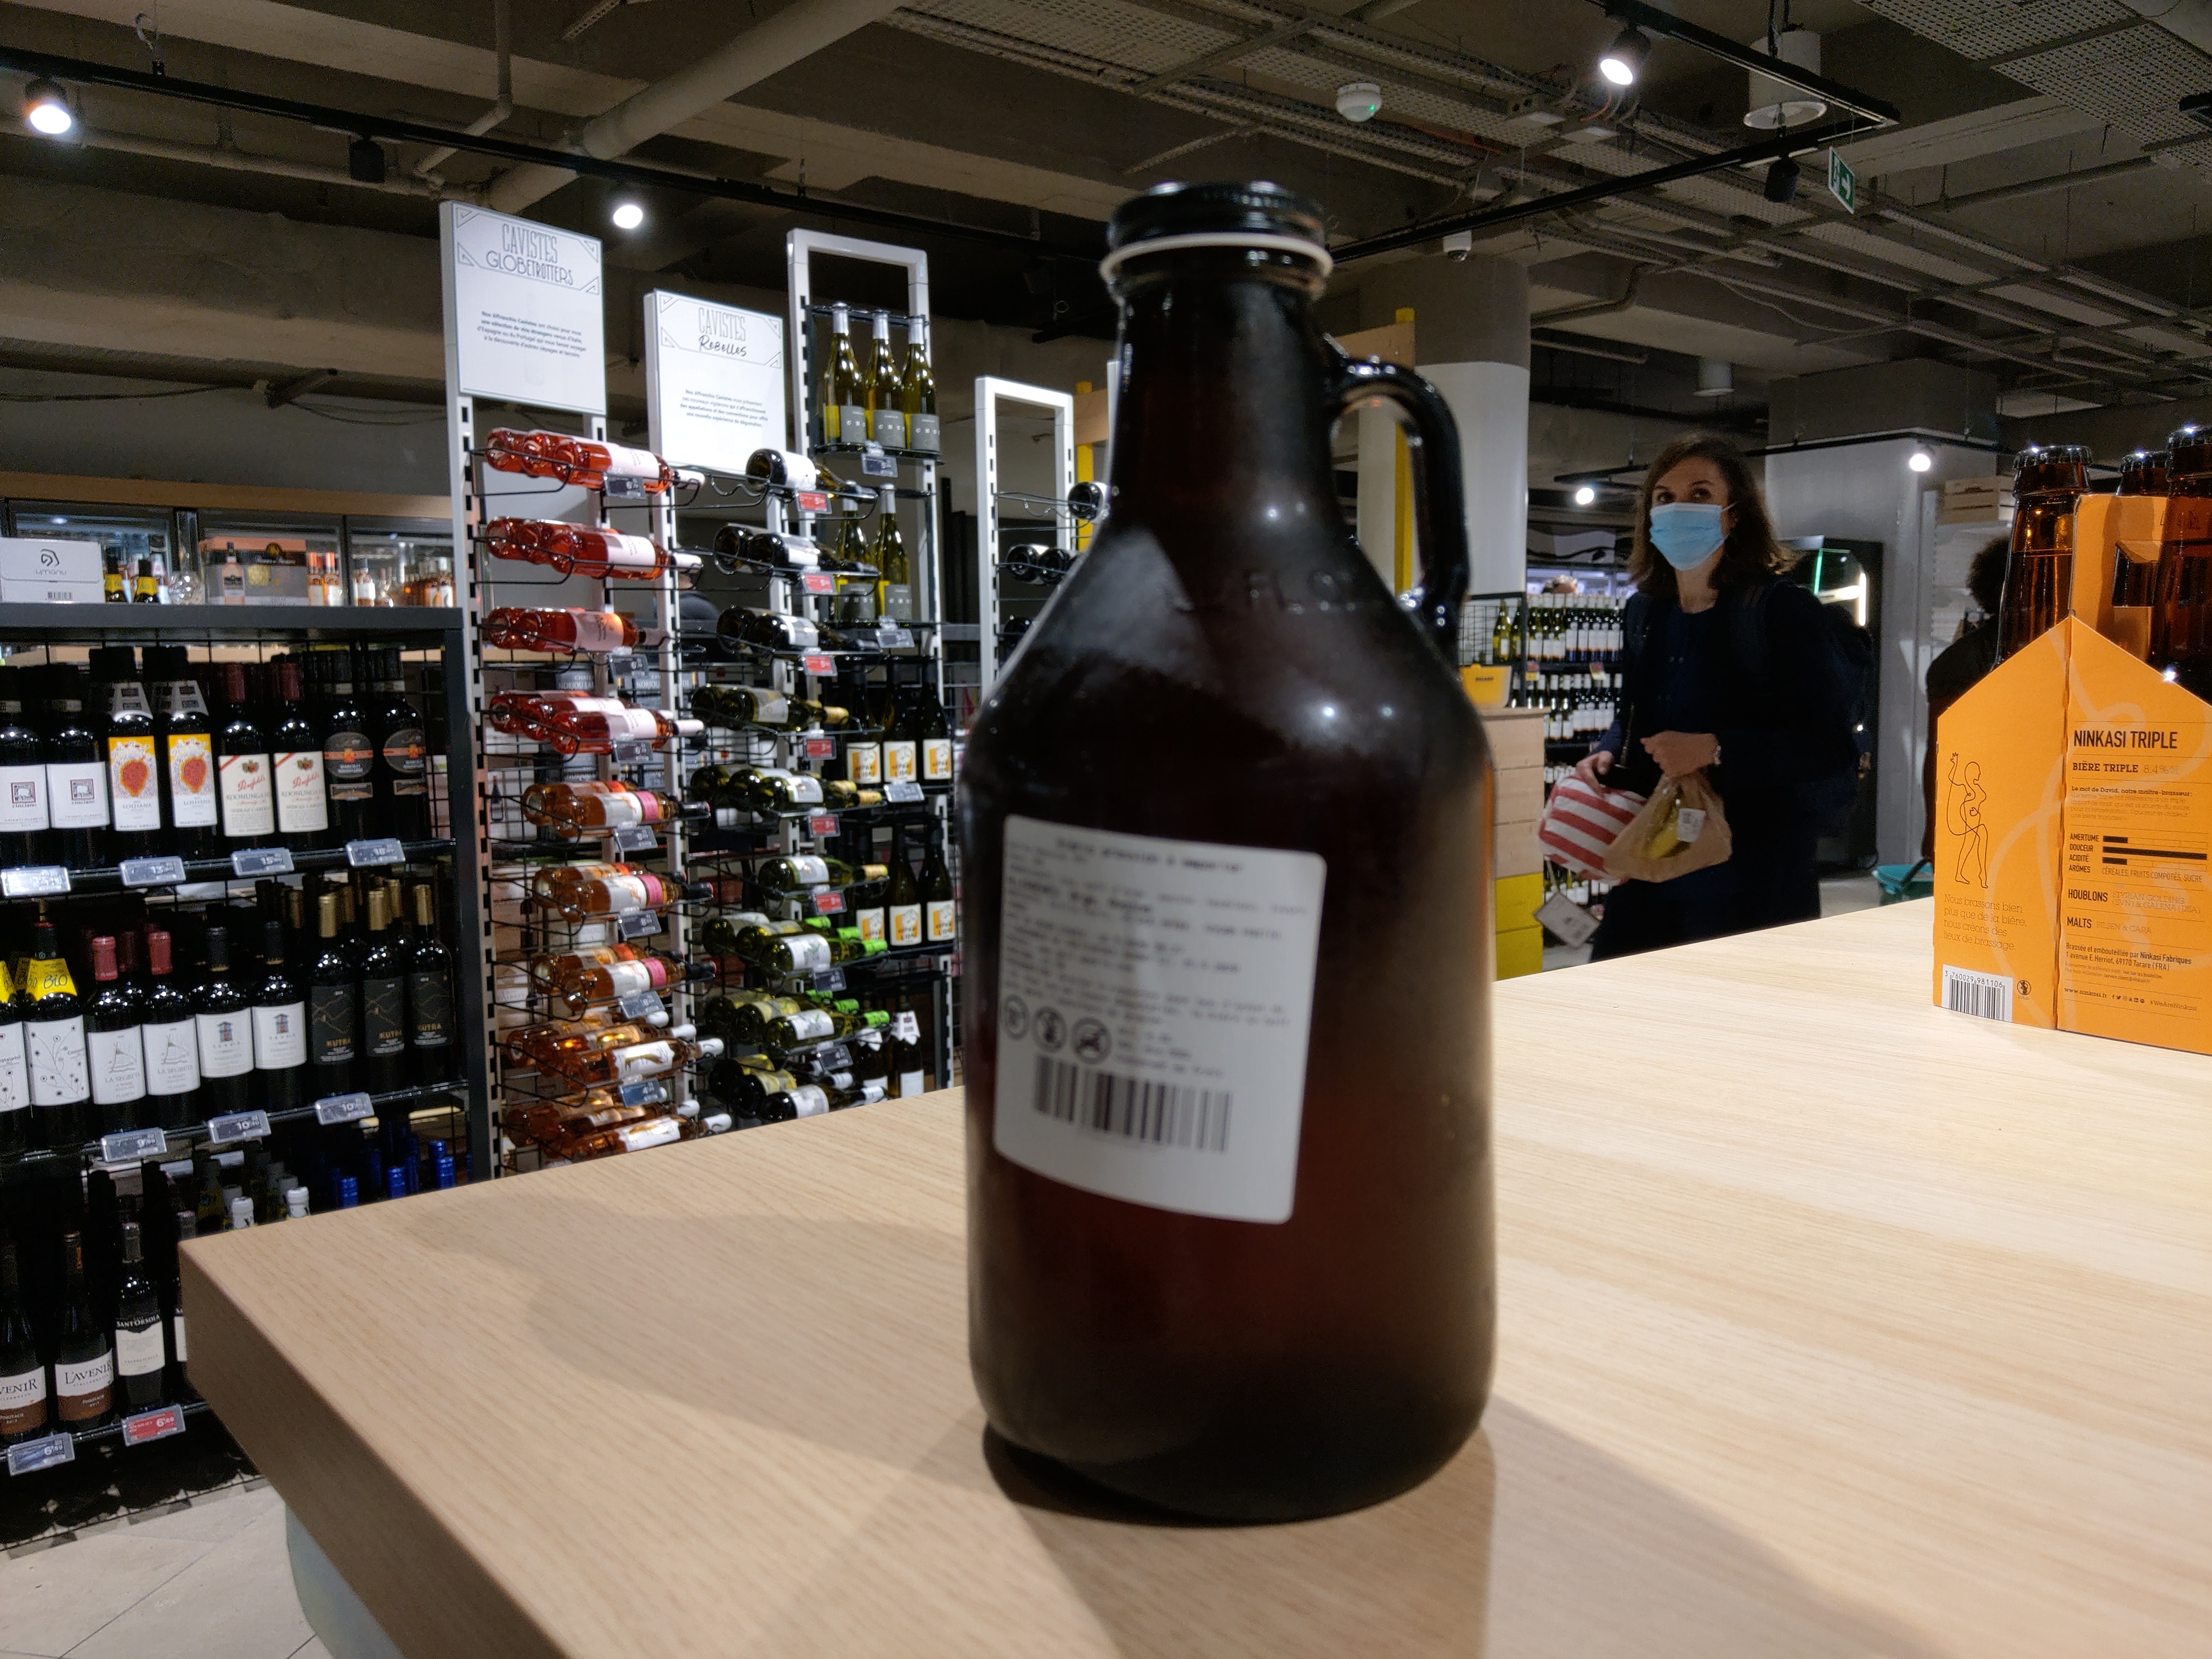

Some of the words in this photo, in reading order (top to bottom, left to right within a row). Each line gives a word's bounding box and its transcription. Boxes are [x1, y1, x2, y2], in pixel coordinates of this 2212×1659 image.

[502, 224, 558, 264] CAVISTES
[486, 250, 574, 286] GLOBETROTTERS
[698, 307, 746, 341] CAVISTES
[2074, 730, 2126, 748] NINKASI
[2130, 731, 2178, 749] TRIPLE
[2073, 760, 2100, 771] BIÈRE
[2103, 763, 2138, 773] TRIPLE
[2070, 833, 2099, 842] AMERTUME
[2069, 844, 2094, 852] DOUCEUR
[2069, 853, 2089, 862] ACIDITÉ
[2069, 864, 2091, 873] ARÔMES
[2130, 868, 2150, 878] FRUITS
[2184, 874, 2203, 883] SUCRE
[1944, 894, 1962, 905] Nous
[1964, 896, 2000, 911] brassons
[2002, 901, 2023, 913] bien
[2068, 889, 2108, 902] HOUBLONS
[2113, 891, 2145, 900] STYRIAN
[2146, 895, 2185, 904] GOLDING
[1944, 906, 1959, 917] plus
[1960, 911, 1976, 919] que
[1977, 912, 1989, 921] de
[1991, 913, 1999, 923] la
[2143, 902, 2176, 911] GALENA
[2177, 905, 2200, 915] (USA)
[1944, 919, 1961, 929] nous
[1962, 923, 1989, 934] créons
[1991, 926, 2007, 937] des
[2067, 916, 2092, 929] MALTS
[2129, 925, 2152, 934] CARA
[1944, 930, 1961, 941] lieux
[1962, 934, 1972, 944] de
[1974, 935, 2017, 952] brassage.
[2066, 942, 2086, 951] Brassée
[2094, 947, 2129, 957] embouteillée
[2140, 951, 2162, 961] Ninkasi
[2162, 954, 2192, 965] Fabriques
[2115, 958, 2132, 967] 69170
[2133, 960, 2151, 969] Tarare
[2152, 963, 2170, 971] (FRA)
[1952, 972, 1974, 983] 760029
[1977, 977, 2002, 988] 981106
[2064, 987, 2107, 998] www.ninkasi.fr
[65, 1359, 112, 1385] L'AVENIR
